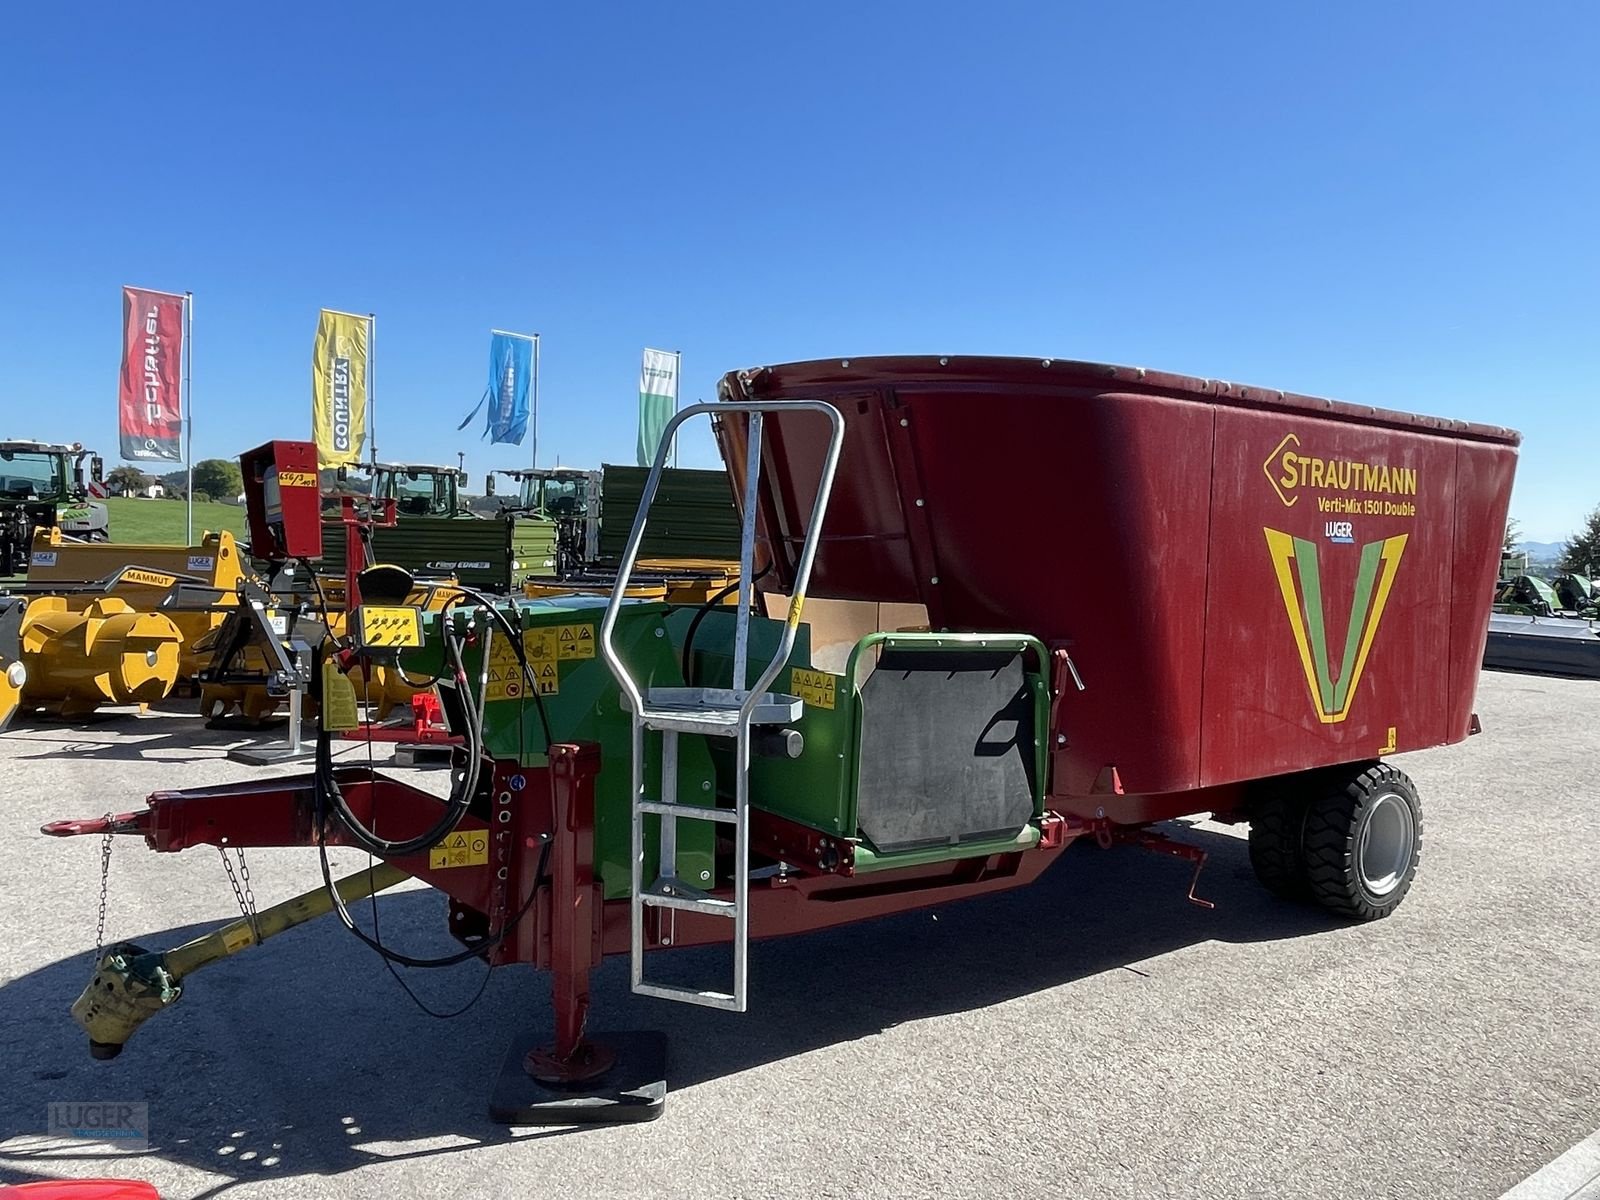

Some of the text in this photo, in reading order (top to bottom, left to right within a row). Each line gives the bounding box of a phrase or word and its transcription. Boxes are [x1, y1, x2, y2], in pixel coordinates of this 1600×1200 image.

[1280, 451, 1417, 495] STRAUTMANN
[1317, 497, 1416, 517] Verti-Mix 1501 Double
[1325, 521, 1353, 538] LUGER
[127, 571, 169, 585] MAMMUT
